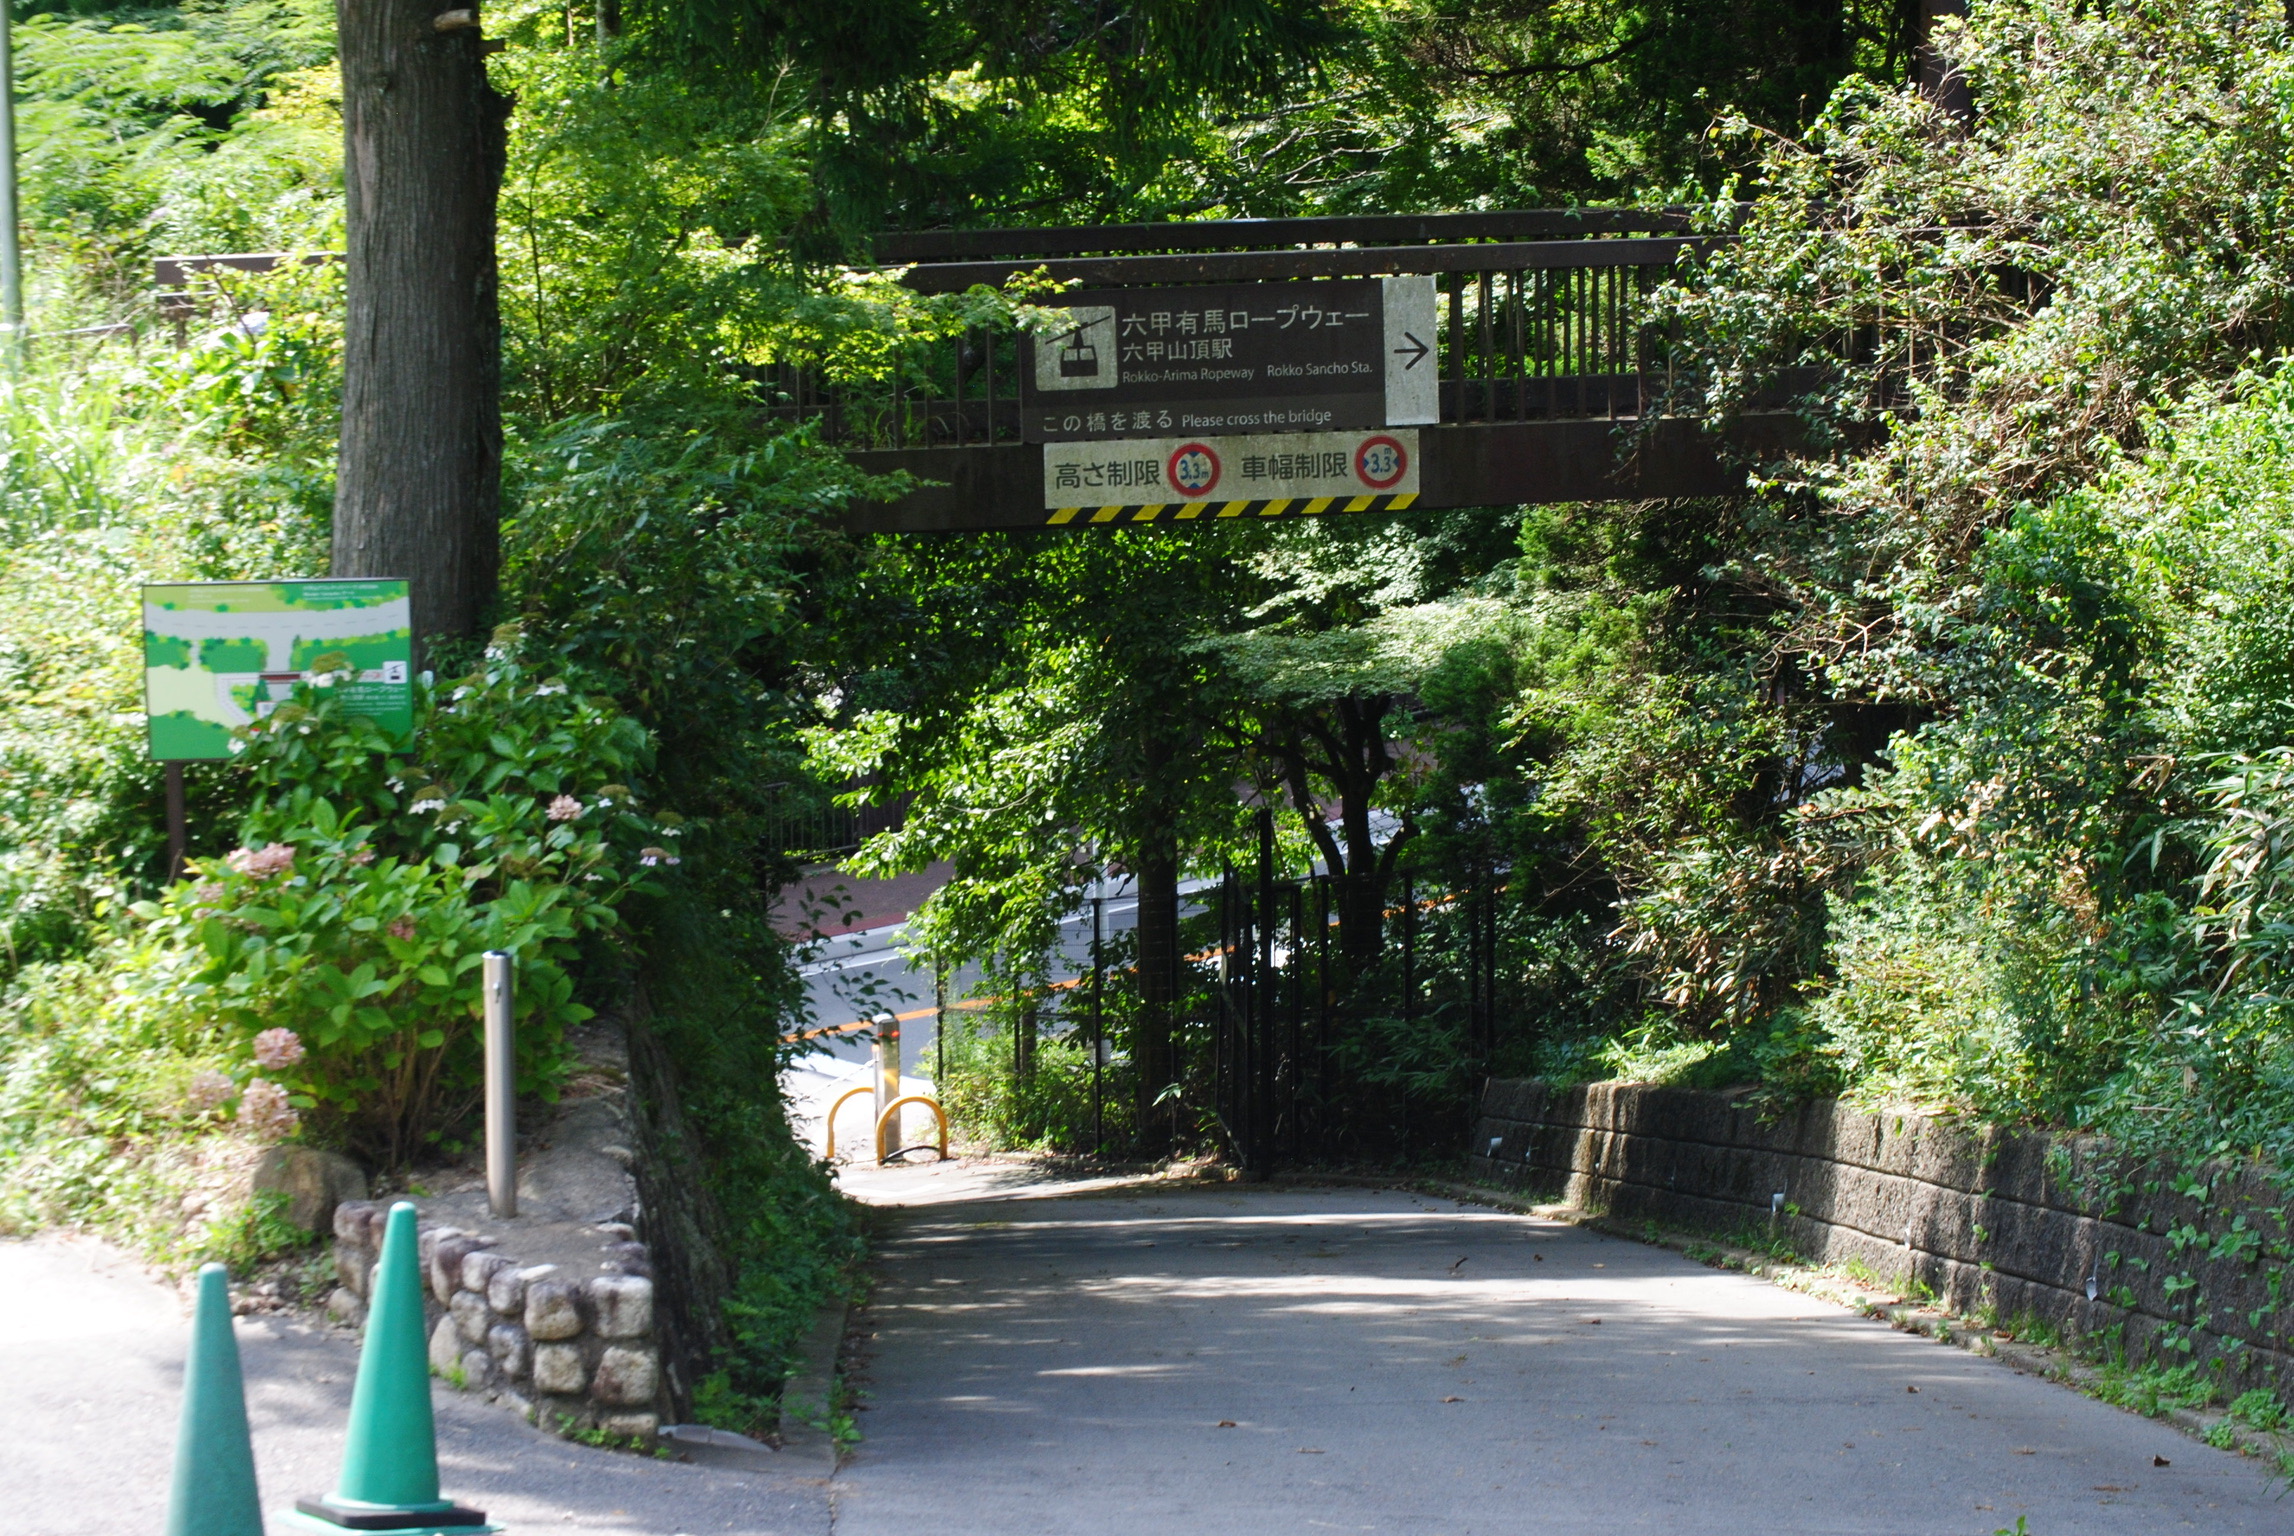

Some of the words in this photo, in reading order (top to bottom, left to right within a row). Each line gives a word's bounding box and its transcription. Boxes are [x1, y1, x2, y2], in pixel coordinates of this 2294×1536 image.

[1122, 305, 1369, 336] 六甲有馬ロープウェー
[1123, 338, 1233, 362] 六甲山頂駅
[1123, 369, 1198, 384] Rokko-Arima
[1201, 366, 1254, 382] Ropeway
[1267, 364, 1303, 377] Rokko
[1306, 363, 1348, 376] Sancho
[1351, 362, 1373, 374] Sta.
[1043, 410, 1173, 432] この橋を渡る
[1182, 414, 1223, 428] Please
[1227, 413, 1261, 425] cross
[1264, 411, 1285, 424] the
[1289, 408, 1331, 425] bridge
[1055, 460, 1160, 489] 高さ制限
[1241, 452, 1348, 482] 車幅制限
